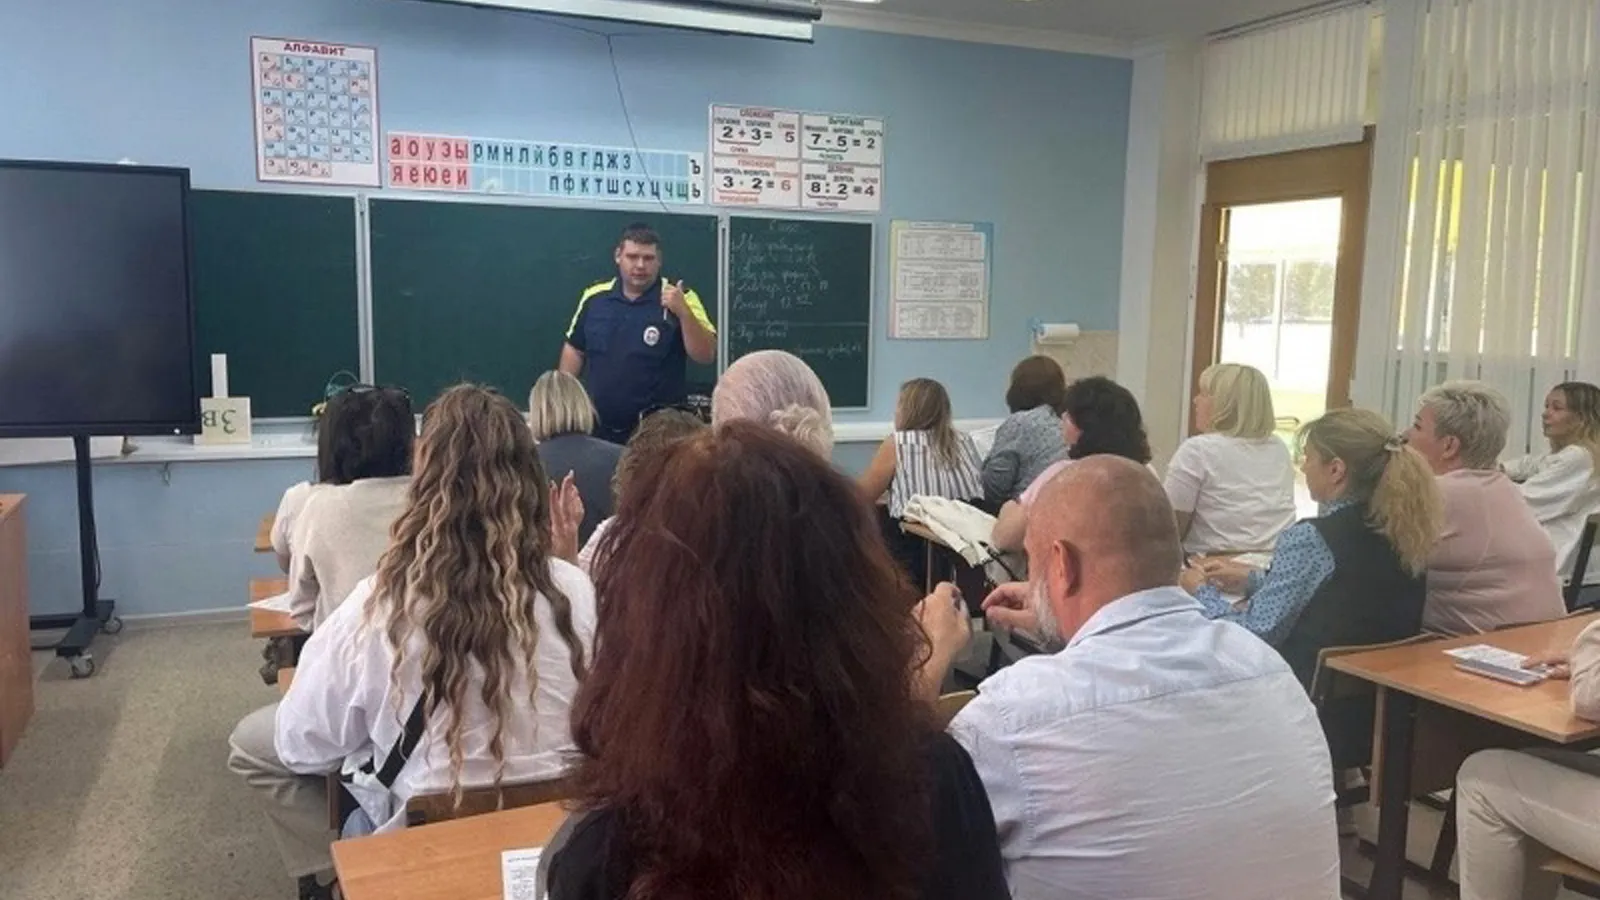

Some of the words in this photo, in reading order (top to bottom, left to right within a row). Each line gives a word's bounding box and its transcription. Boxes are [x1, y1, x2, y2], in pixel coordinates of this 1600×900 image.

[284, 43, 346, 56] АЛФАВИТ
[722, 126, 733, 139] 2
[784, 131, 795, 143] 5
[811, 133, 822, 145] 7
[837, 135, 847, 147] 5
[866, 137, 876, 150] 2
[723, 175, 734, 188] 3
[751, 177, 763, 190] 2
[781, 180, 791, 192] 6
[810, 181, 821, 193] 8
[837, 183, 847, 195] 2
[864, 185, 875, 196] 4
